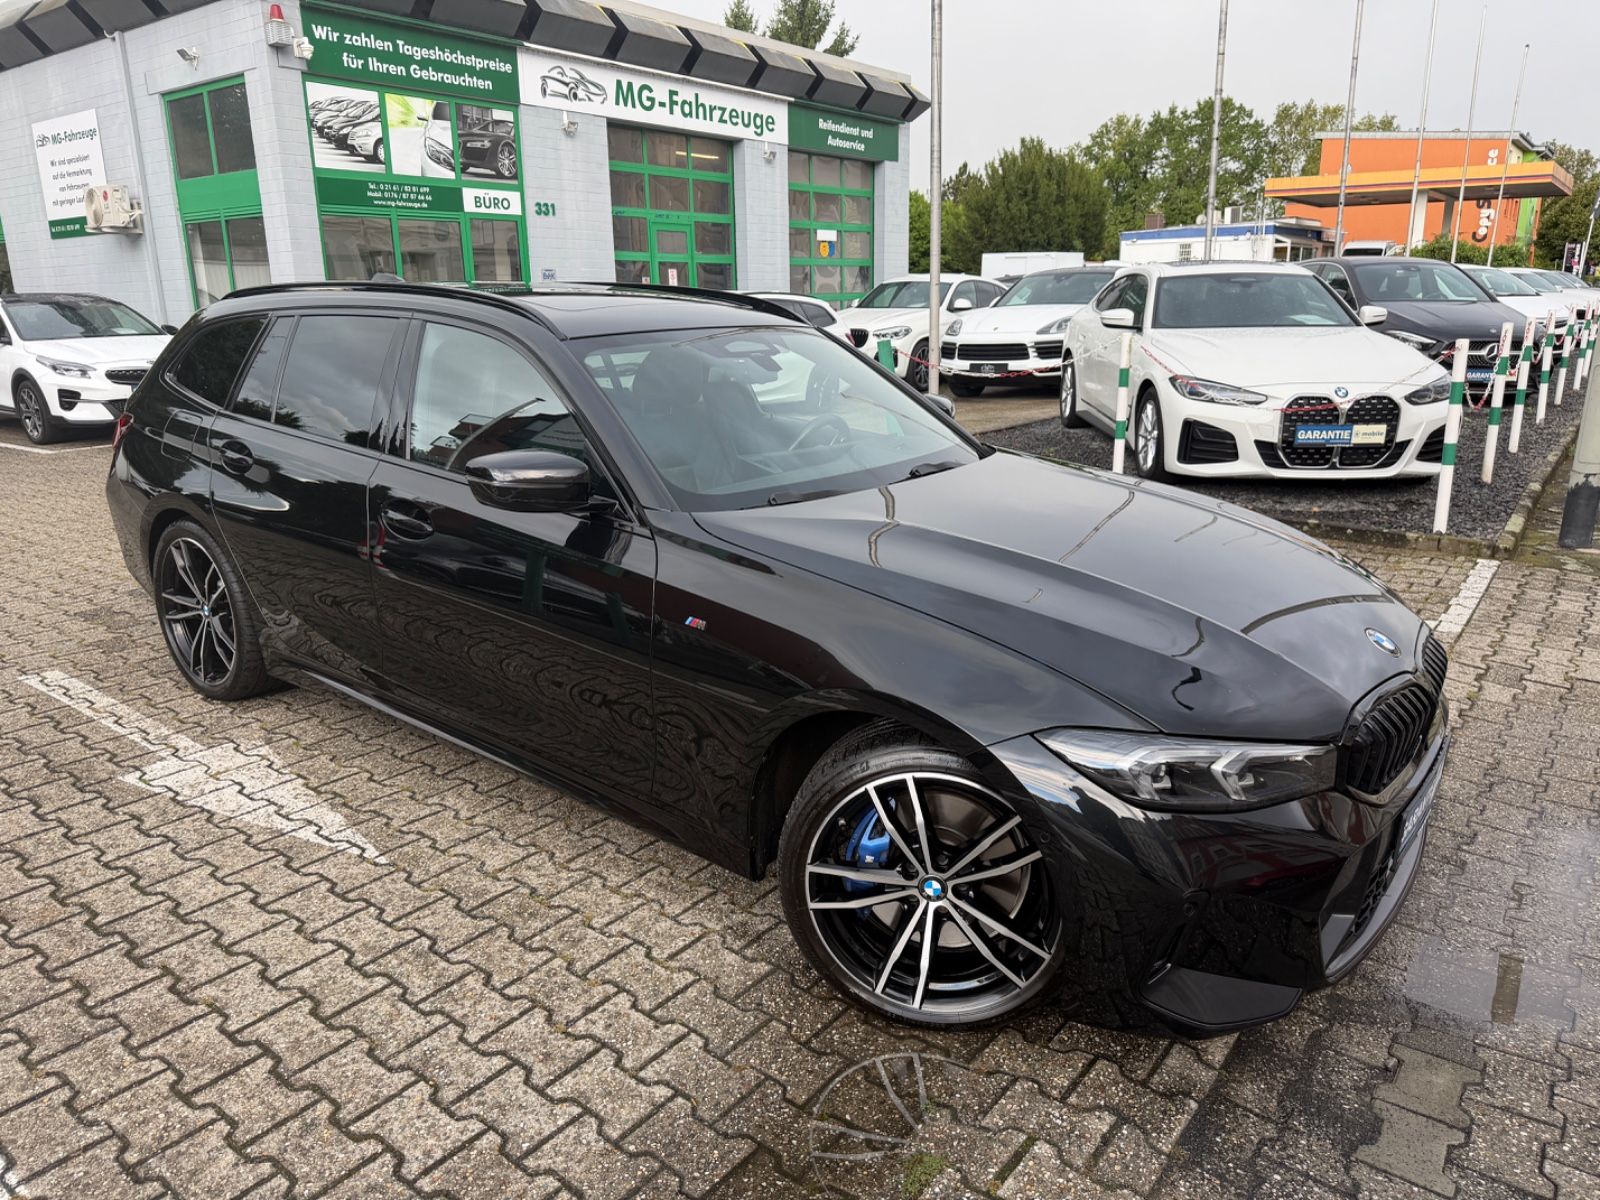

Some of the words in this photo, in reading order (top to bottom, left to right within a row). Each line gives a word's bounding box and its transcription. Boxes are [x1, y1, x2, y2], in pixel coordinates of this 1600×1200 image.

[311, 24, 340, 43] Wir
[344, 32, 393, 52] zahlen
[396, 40, 513, 74] Tageshöchstpreise
[342, 53, 364, 70] für
[368, 57, 406, 76] Ihren
[410, 65, 493, 90] Gebrauchten
[614, 79, 775, 137] MG-Fahrzeuge
[51, 127, 97, 145] MG-Fahrzeuge
[818, 118, 860, 136] Reifendienst
[861, 127, 873, 139] und
[827, 134, 865, 152] Autoservice
[474, 192, 511, 210] BÜRO
[535, 202, 556, 216] 331
[1298, 430, 1352, 439] GARANTIE
